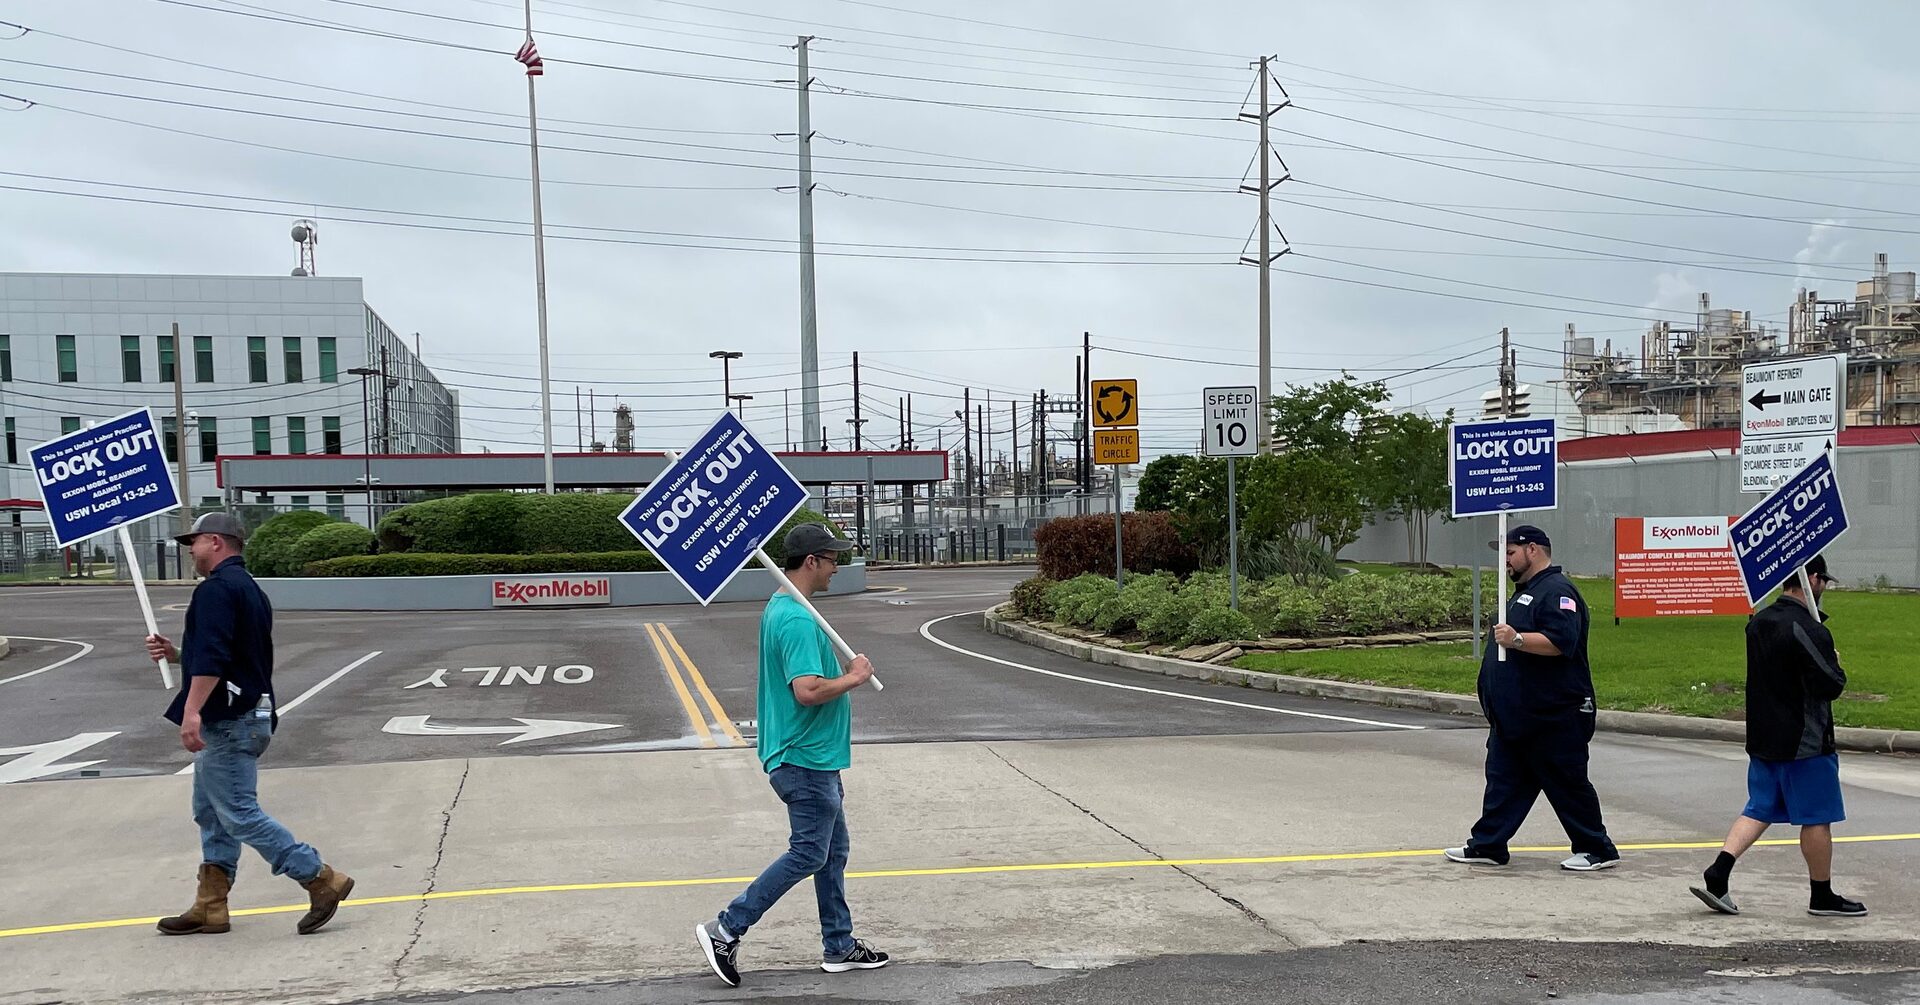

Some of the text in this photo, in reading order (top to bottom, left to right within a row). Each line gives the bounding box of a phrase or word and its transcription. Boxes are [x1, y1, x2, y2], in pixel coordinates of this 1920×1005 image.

[1745, 368, 1803, 384] BEAUMONT REFINERY
[1208, 394, 1253, 406] SPEED
[1783, 387, 1831, 404] MAIN GATE
[1213, 408, 1248, 419] LIMIT
[1746, 414, 1833, 430] ExxonMobil EMPLOYEES ONLY
[41, 454, 56, 462] This
[73, 440, 94, 450] Unfair
[94, 433, 113, 443] Labor
[114, 423, 142, 436] Practice
[1100, 435, 1133, 446] TRAFFIC
[1216, 422, 1247, 447] 10
[38, 429, 153, 486] LOCK OUT
[1103, 449, 1131, 459] CIRCLE
[1456, 436, 1553, 460] LOCK OUT
[1744, 442, 1803, 455] BEAUMONT LUBE PLANT
[639, 507, 655, 521] This
[662, 491, 671, 501] an
[669, 472, 689, 492] Unfair
[688, 454, 707, 473] Labor
[705, 429, 732, 455] Practice
[1509, 465, 1541, 473] BEAUMONT
[1744, 460, 1771, 470] SYCAMORE
[1773, 458, 1793, 469] STREET
[62, 464, 147, 499] EXXON MOBIL BEAUMONT
[93, 483, 122, 498] AGAINST
[642, 430, 754, 548] LOCK OUT
[1466, 482, 1544, 496] USW Local 13-243
[1744, 476, 1769, 486] BLENDING
[65, 483, 158, 522] USW Local 13-243
[681, 470, 758, 550] EXXON MOBIL BEAUMONT
[707, 497, 718, 507] By
[1737, 469, 1831, 558] LOCK OUT
[695, 485, 780, 572] USW Local 13-243
[715, 502, 742, 533] AGAINST
[1652, 525, 1719, 540] ExxonMobil
[1739, 525, 1752, 535] This
[1756, 544, 1776, 562] EXXON
[1795, 503, 1826, 531] BEAUMONT
[1782, 528, 1806, 551] AGAINST
[1758, 516, 1834, 580] USW Local 13-243
[494, 580, 608, 603] ExxonMobil
[403, 664, 594, 689] ONLY
